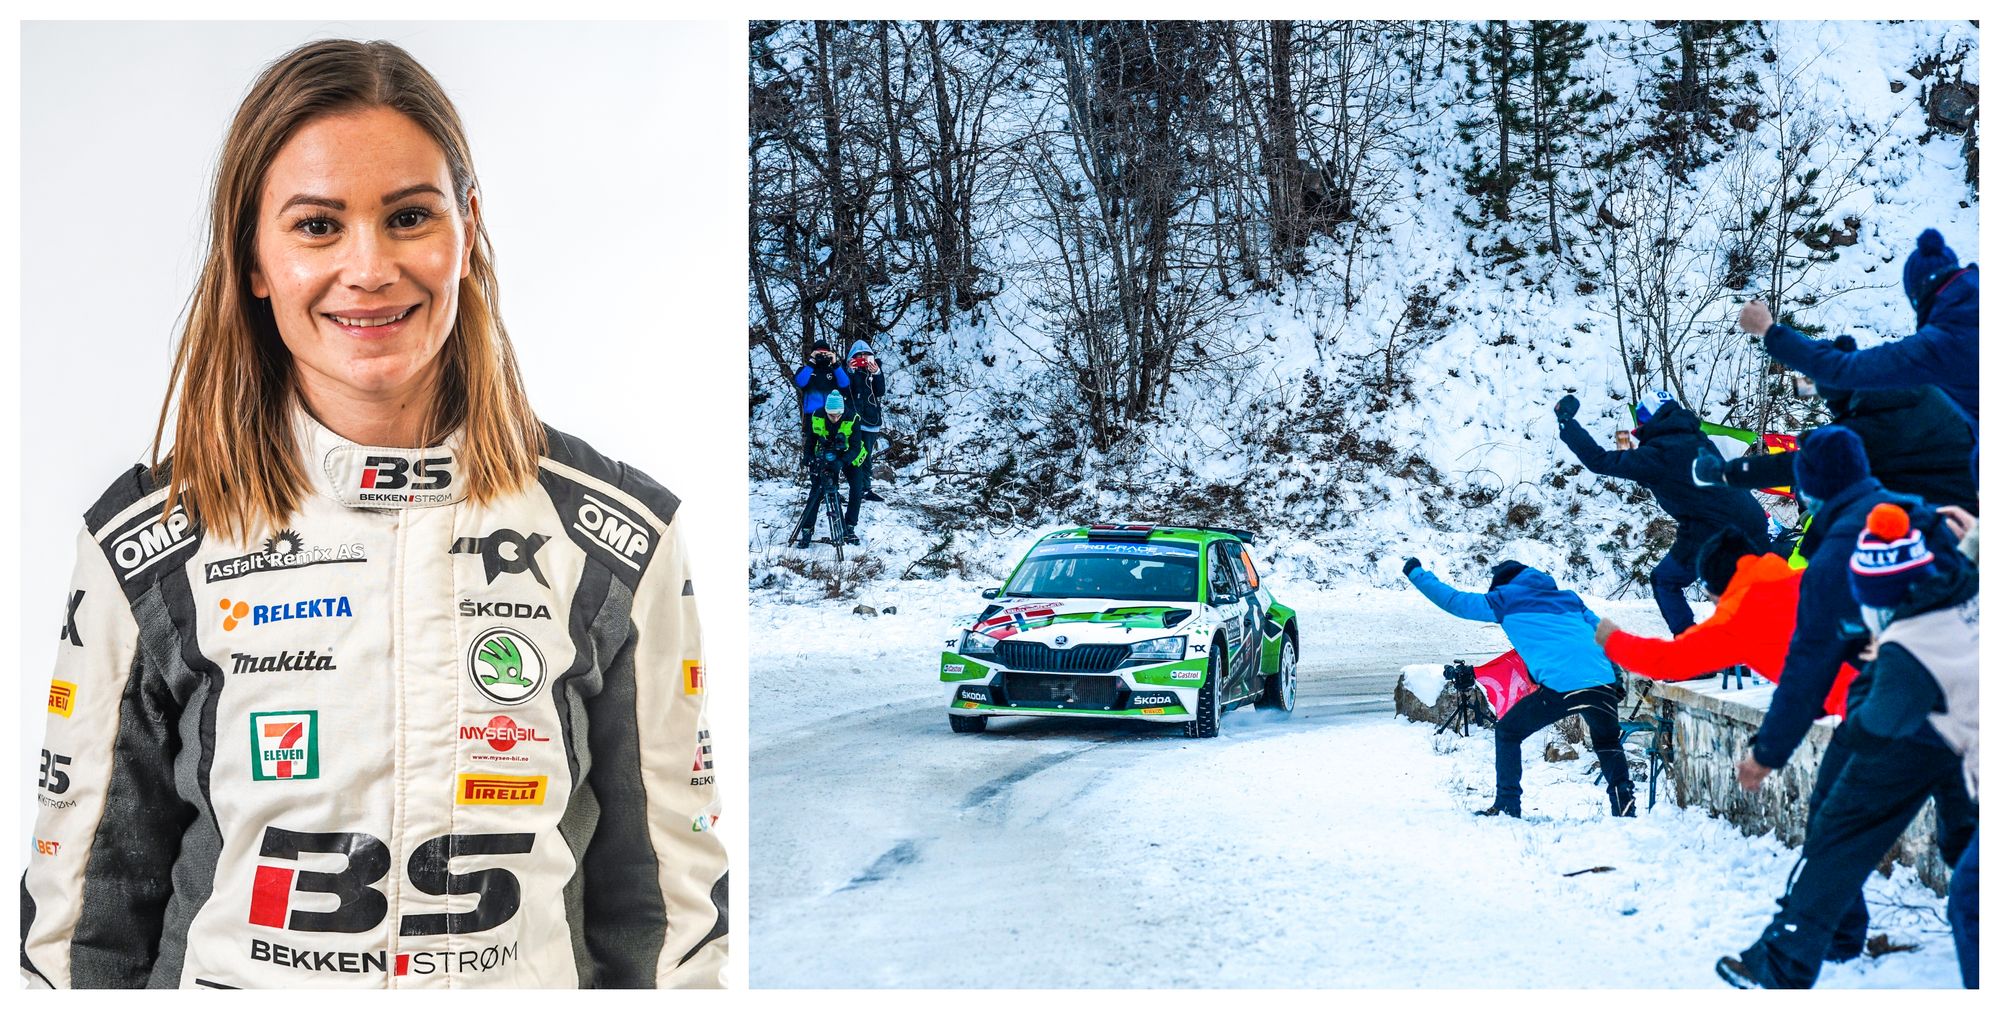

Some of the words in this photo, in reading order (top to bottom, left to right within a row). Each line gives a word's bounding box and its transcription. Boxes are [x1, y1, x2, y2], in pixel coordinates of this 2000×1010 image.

[360, 493, 407, 502] BEKKEN
[577, 503, 649, 558] OMP
[114, 512, 190, 571] OMP
[209, 555, 264, 580] Asfalt
[268, 544, 331, 567] Remix
[337, 543, 365, 560] AS
[253, 596, 353, 626] RELEKTA
[459, 599, 552, 620] ŠKODA
[1177, 671, 1199, 679] Castrol
[962, 690, 987, 701] ŠKODA
[1134, 695, 1172, 705] ŠKODA
[472, 754, 529, 763] www.mysen-bil.no
[464, 779, 539, 800] PIRELLI
[249, 826, 536, 937] BS
[251, 939, 388, 974] BEKKEN
[413, 941, 519, 975] STRØM
